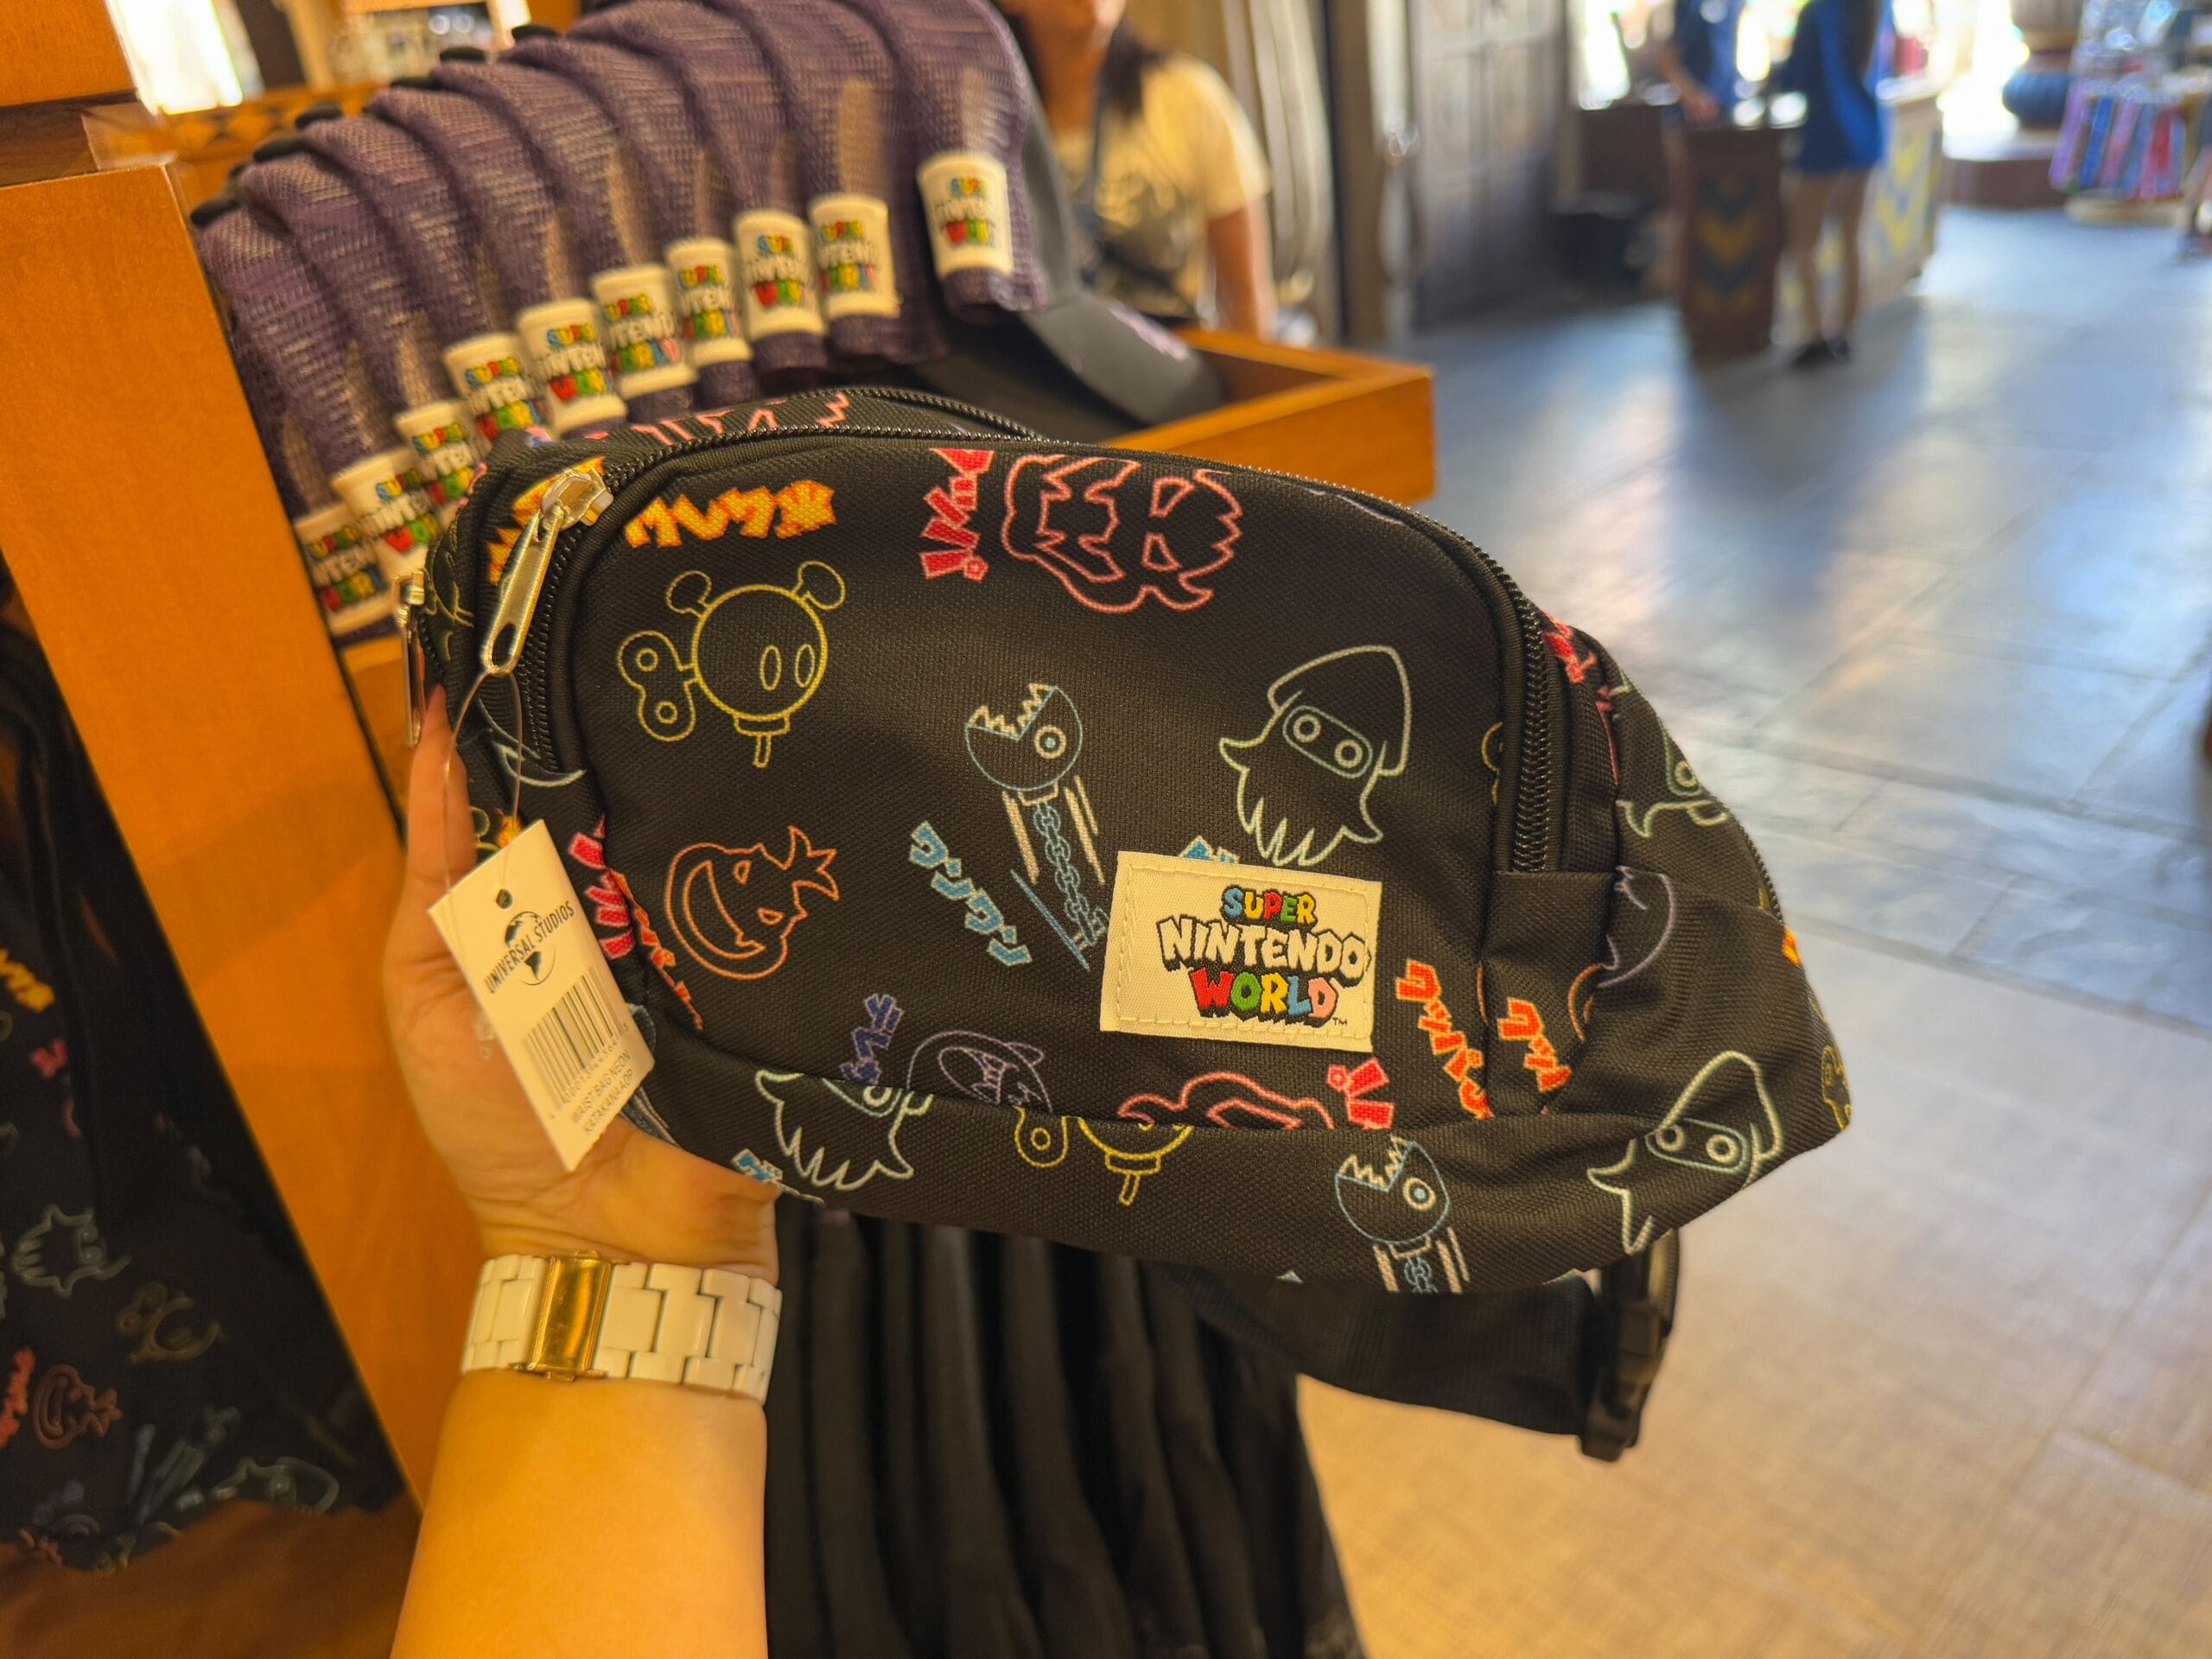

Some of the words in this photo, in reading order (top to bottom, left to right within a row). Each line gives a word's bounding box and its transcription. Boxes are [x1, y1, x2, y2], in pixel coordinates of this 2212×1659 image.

[908, 820, 1033, 967] ワンワン
[1221, 885, 1317, 926] SUPER
[484, 933, 537, 994] UNIVERSAL
[534, 900, 575, 943] STUDIOS
[1156, 915, 1372, 988] NINTENDO
[1189, 967, 1339, 1028] WORLD
[1332, 1017, 1348, 1027] TM
[608, 1047, 631, 1080] NEON
